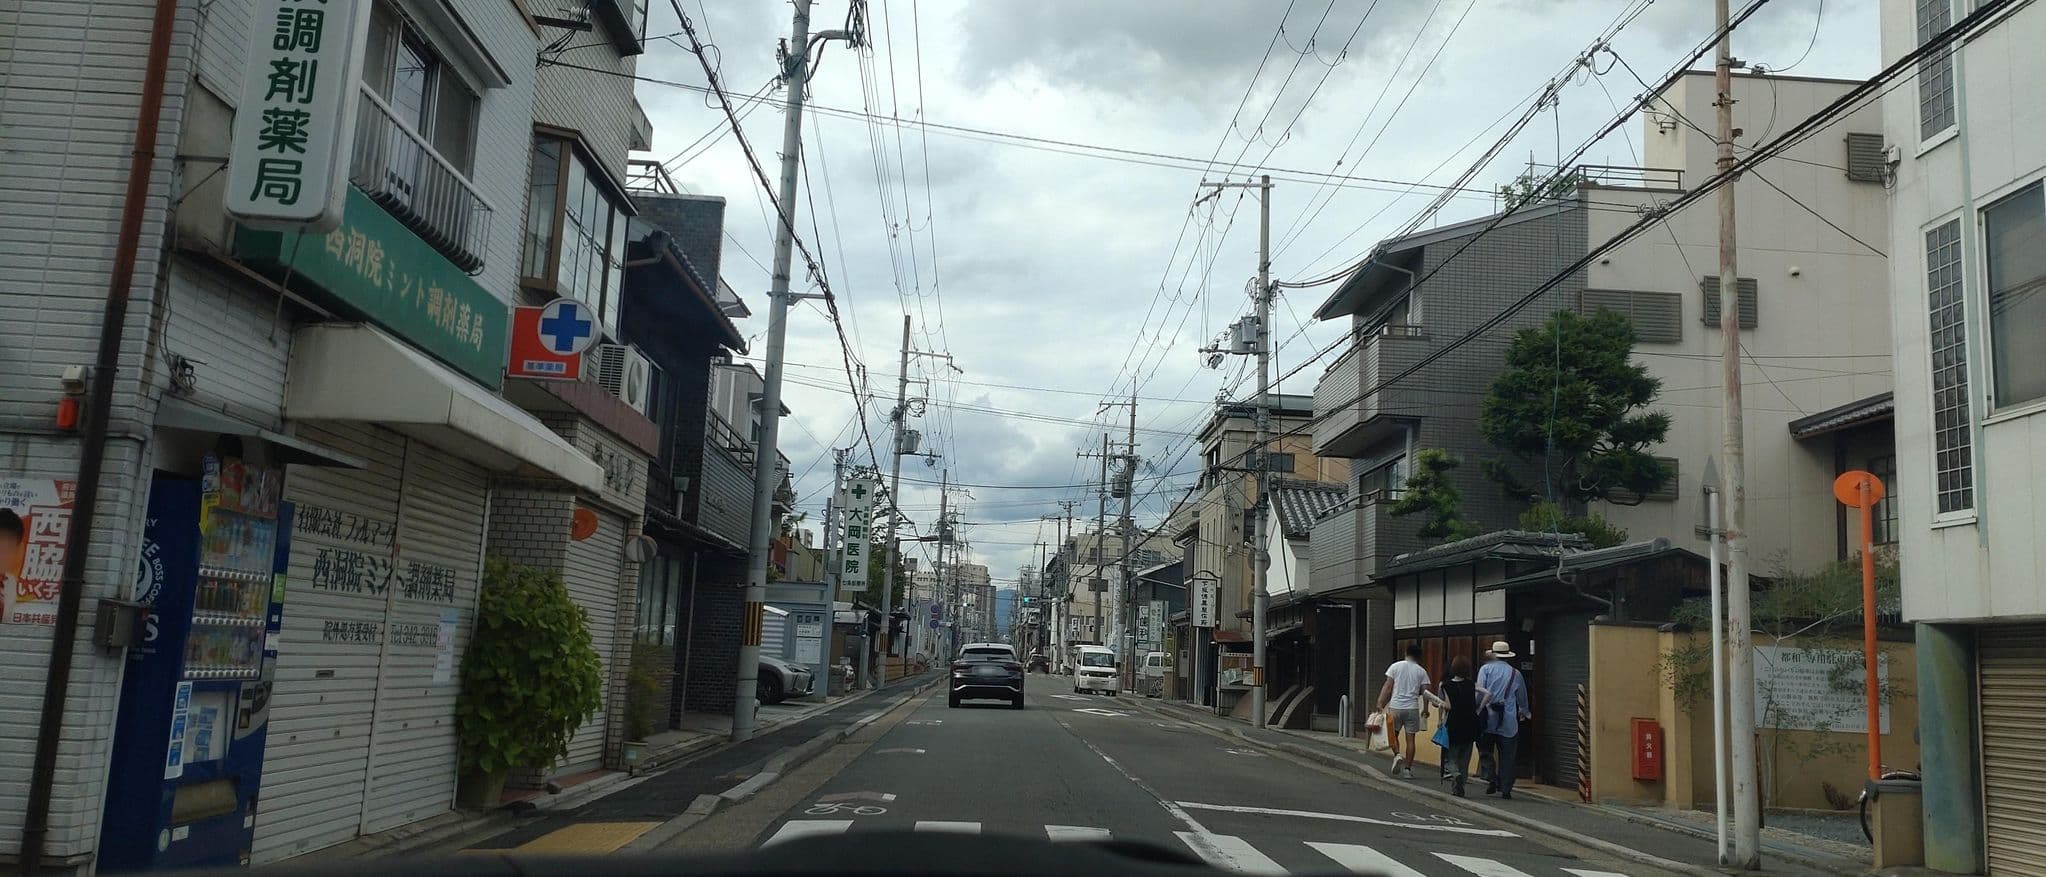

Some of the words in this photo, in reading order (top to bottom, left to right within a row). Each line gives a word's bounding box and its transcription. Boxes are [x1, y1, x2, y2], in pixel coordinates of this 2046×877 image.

[250, 0, 327, 205] 調剤薬局
[326, 226, 484, 352] 西洞院ミント調剤薬局
[20, 507, 74, 582] 西脇
[152, 557, 164, 581] BOSS
[845, 507, 863, 573] 大岡医院
[17, 581, 60, 600] いく子
[312, 547, 457, 602] 西洞院ミント調剤薬局
